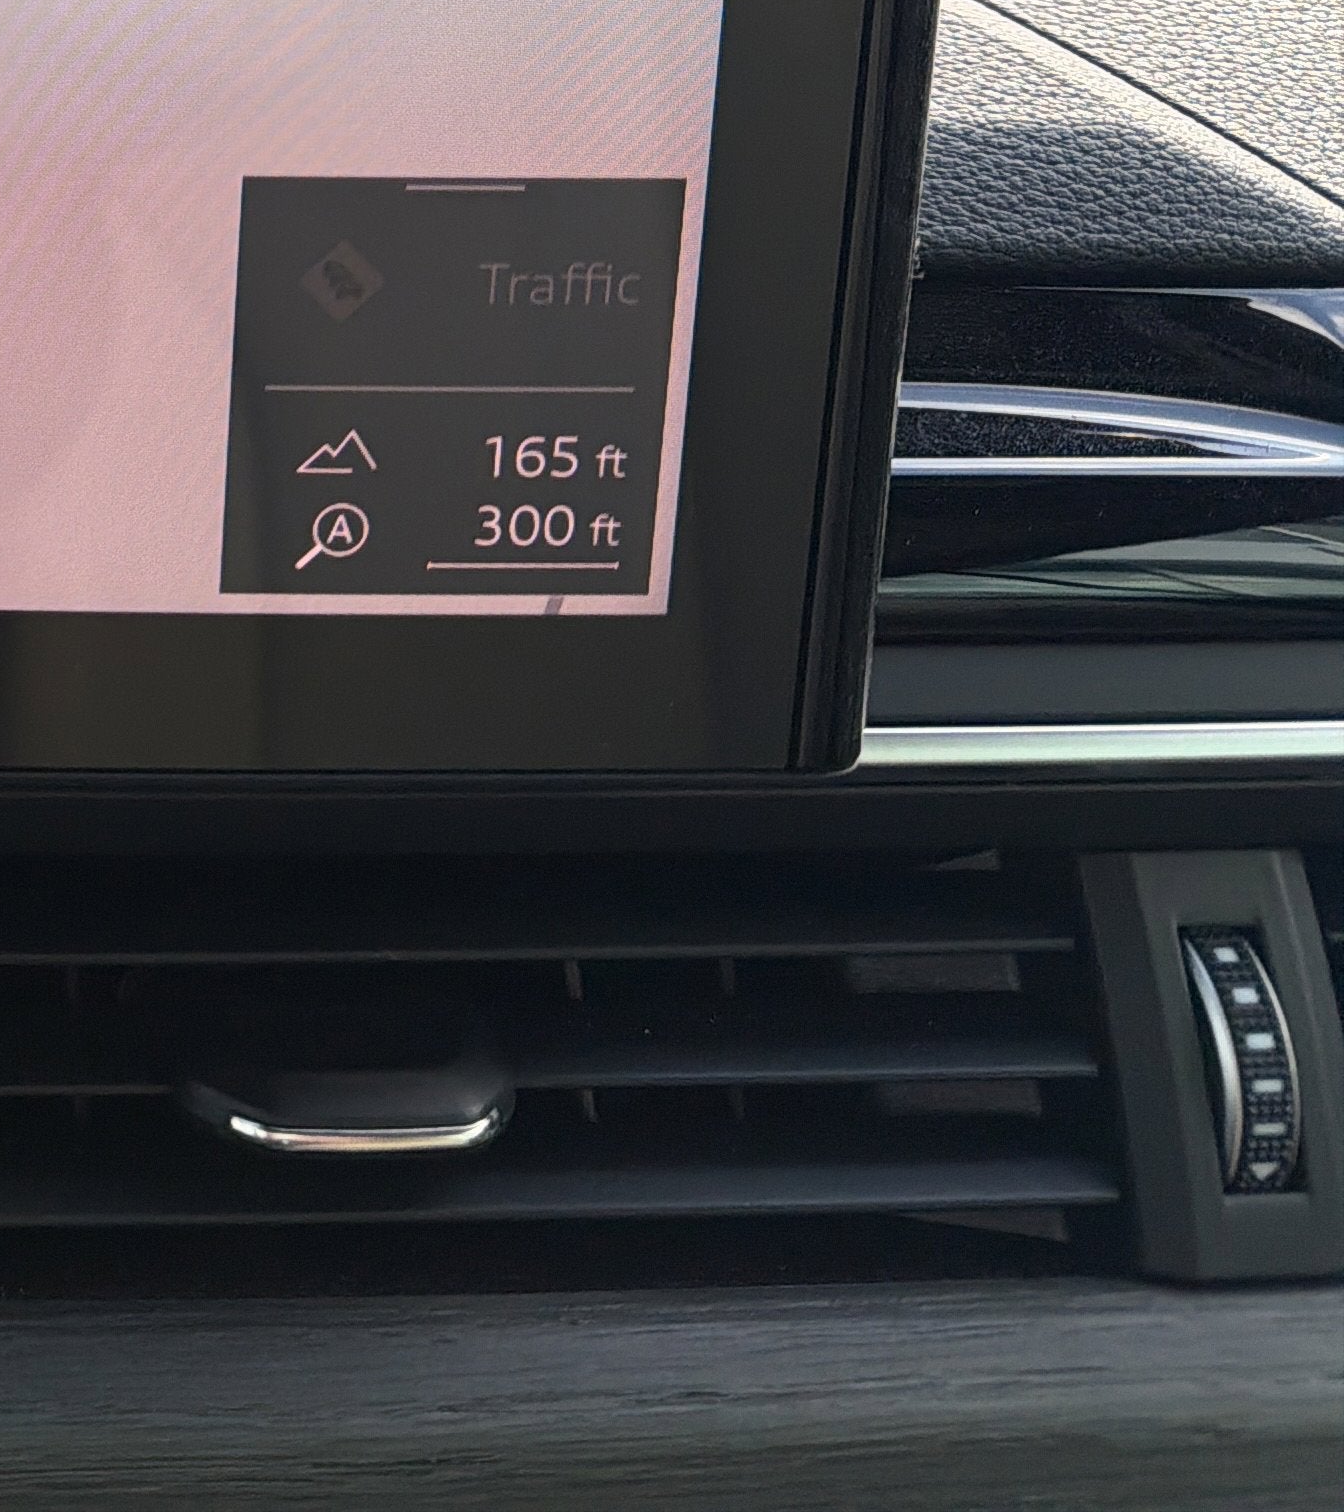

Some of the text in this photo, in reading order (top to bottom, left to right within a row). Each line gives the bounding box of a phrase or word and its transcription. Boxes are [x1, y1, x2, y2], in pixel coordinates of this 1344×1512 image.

[479, 261, 641, 306] Traffic
[485, 435, 628, 479] 165 ft
[473, 504, 622, 547] 300 ft
